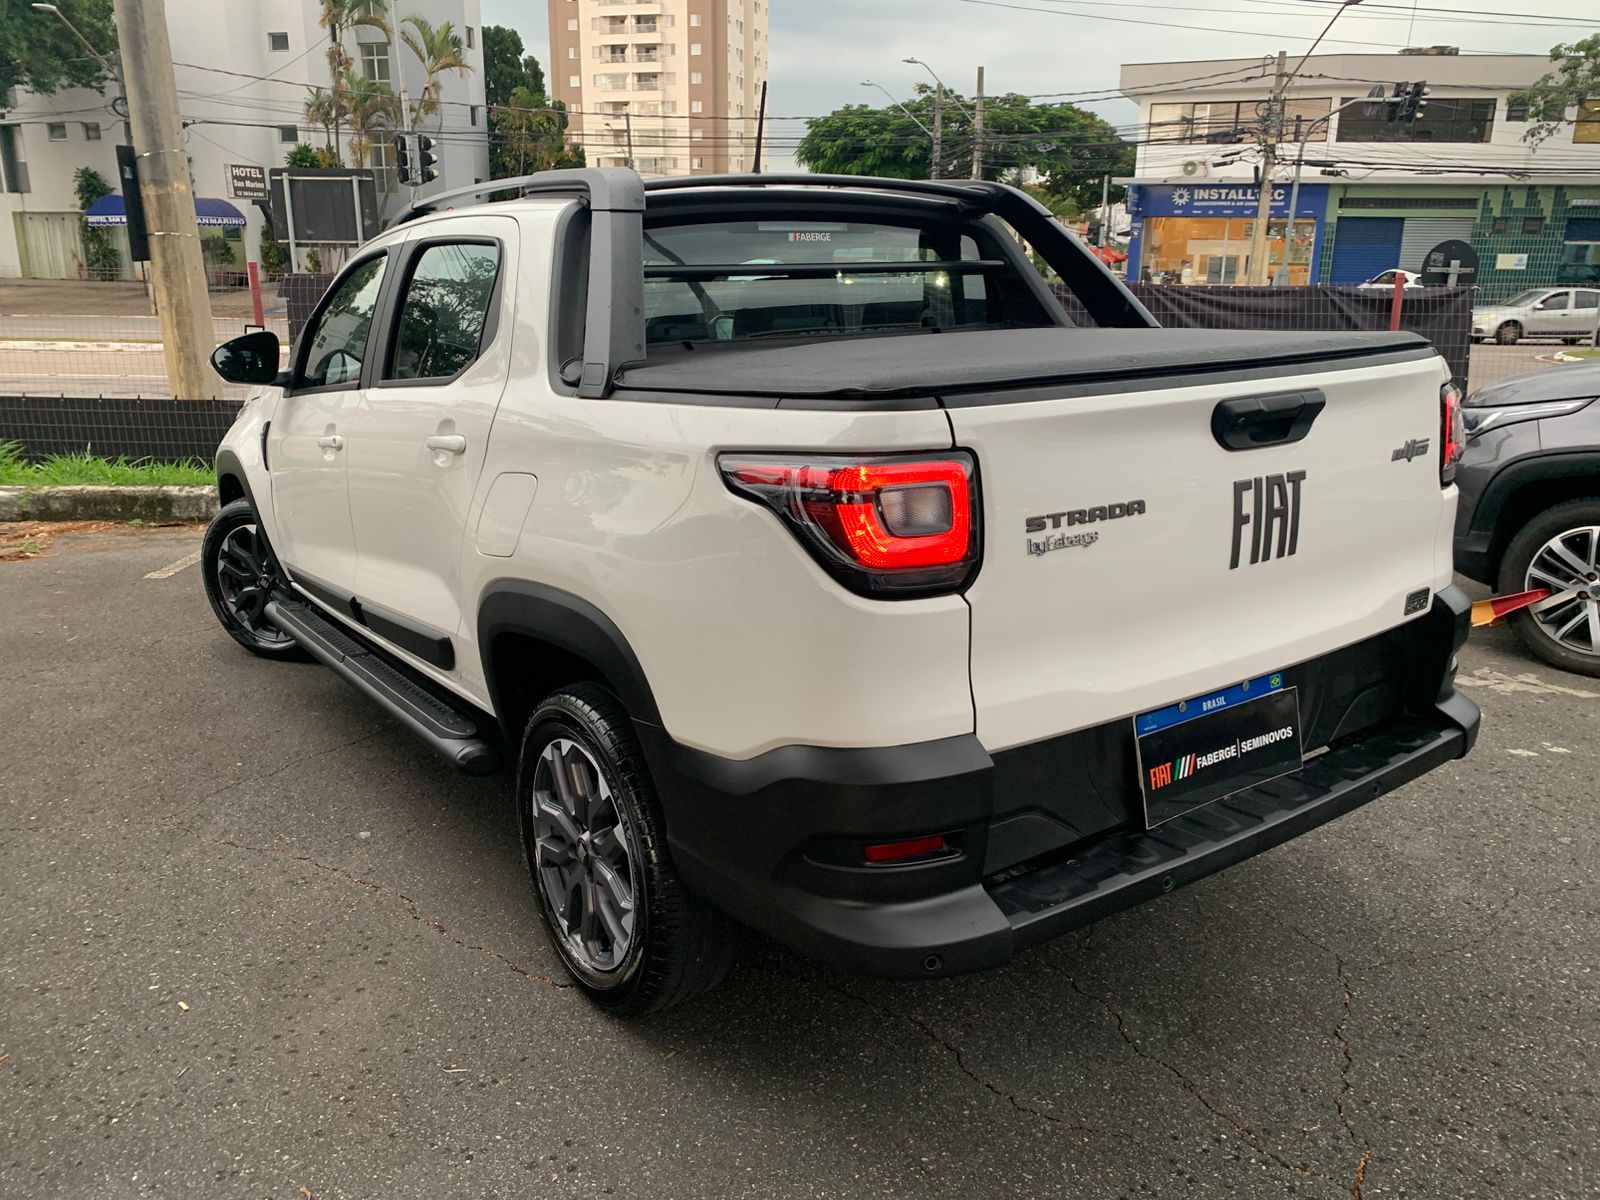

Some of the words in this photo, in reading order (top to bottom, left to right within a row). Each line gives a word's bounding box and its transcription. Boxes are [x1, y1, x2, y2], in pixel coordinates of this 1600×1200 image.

[232, 167, 262, 178] HOTEL
[233, 179, 245, 187] San
[245, 180, 265, 189] Marino
[1193, 189, 1285, 200] INSTALLC
[796, 232, 831, 242] FABERGE
[1025, 499, 1146, 533] STRADA
[1229, 469, 1306, 570] FIAT
[1202, 695, 1227, 712] BRASIL
[1149, 762, 1172, 791] FIAT
[1196, 744, 1237, 770] FABERGE
[1241, 726, 1293, 753] SEMINOVOS
